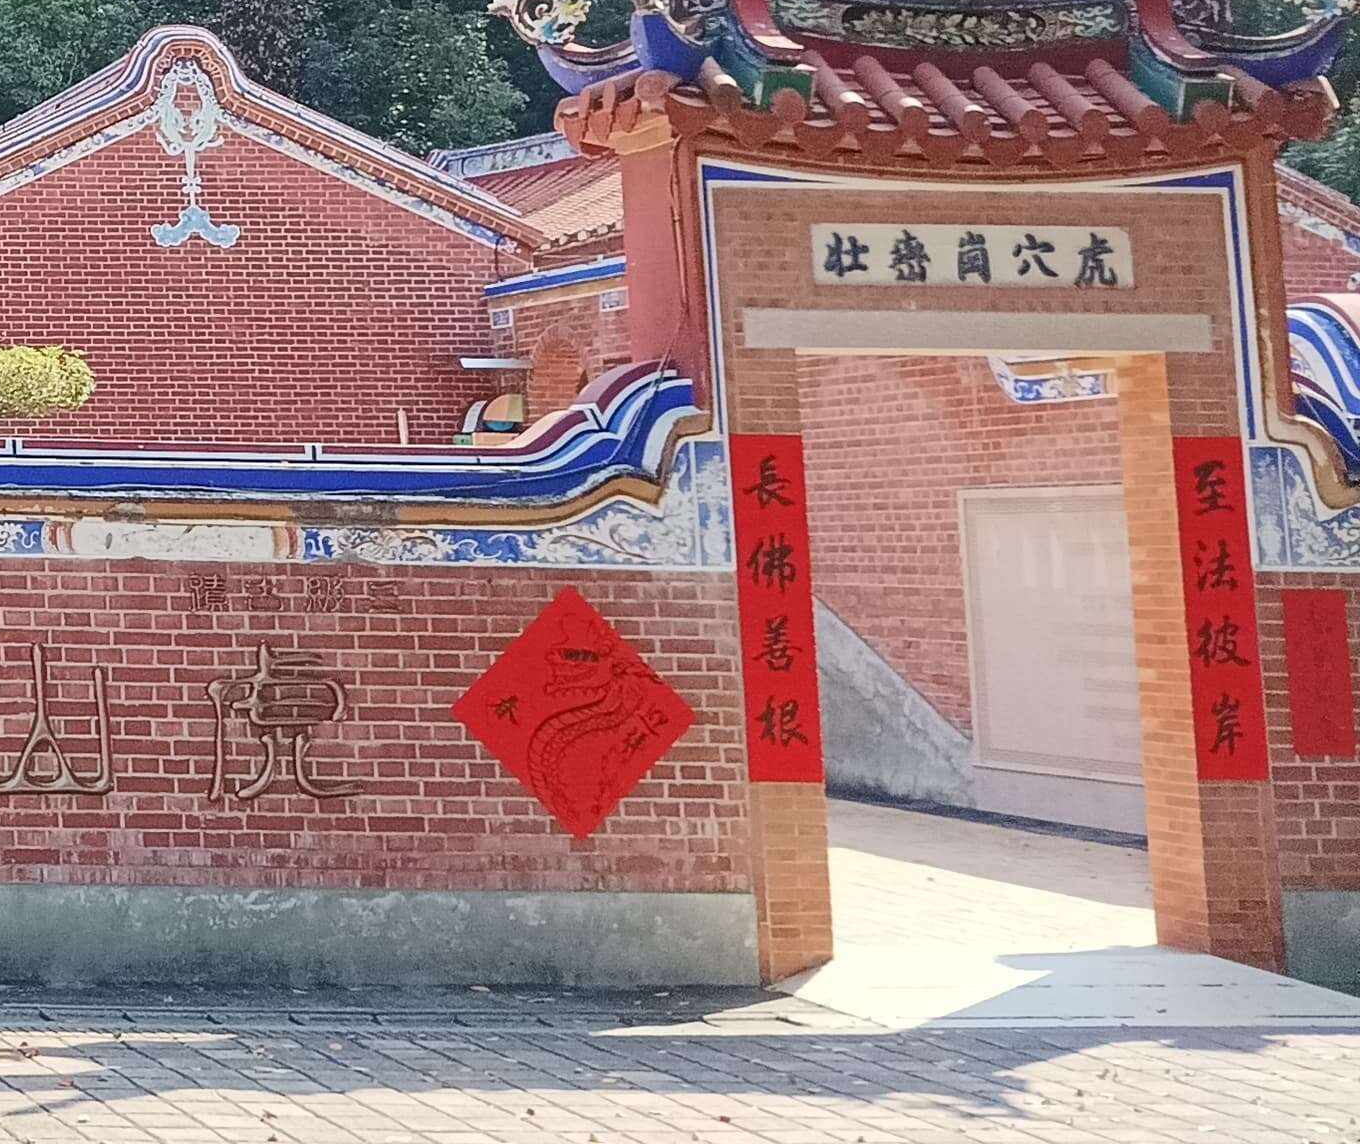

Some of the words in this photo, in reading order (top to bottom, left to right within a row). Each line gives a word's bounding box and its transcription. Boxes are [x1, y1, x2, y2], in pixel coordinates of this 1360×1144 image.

[742, 453, 809, 747] 長佛善根
[1188, 459, 1252, 756] 至法彼岸
